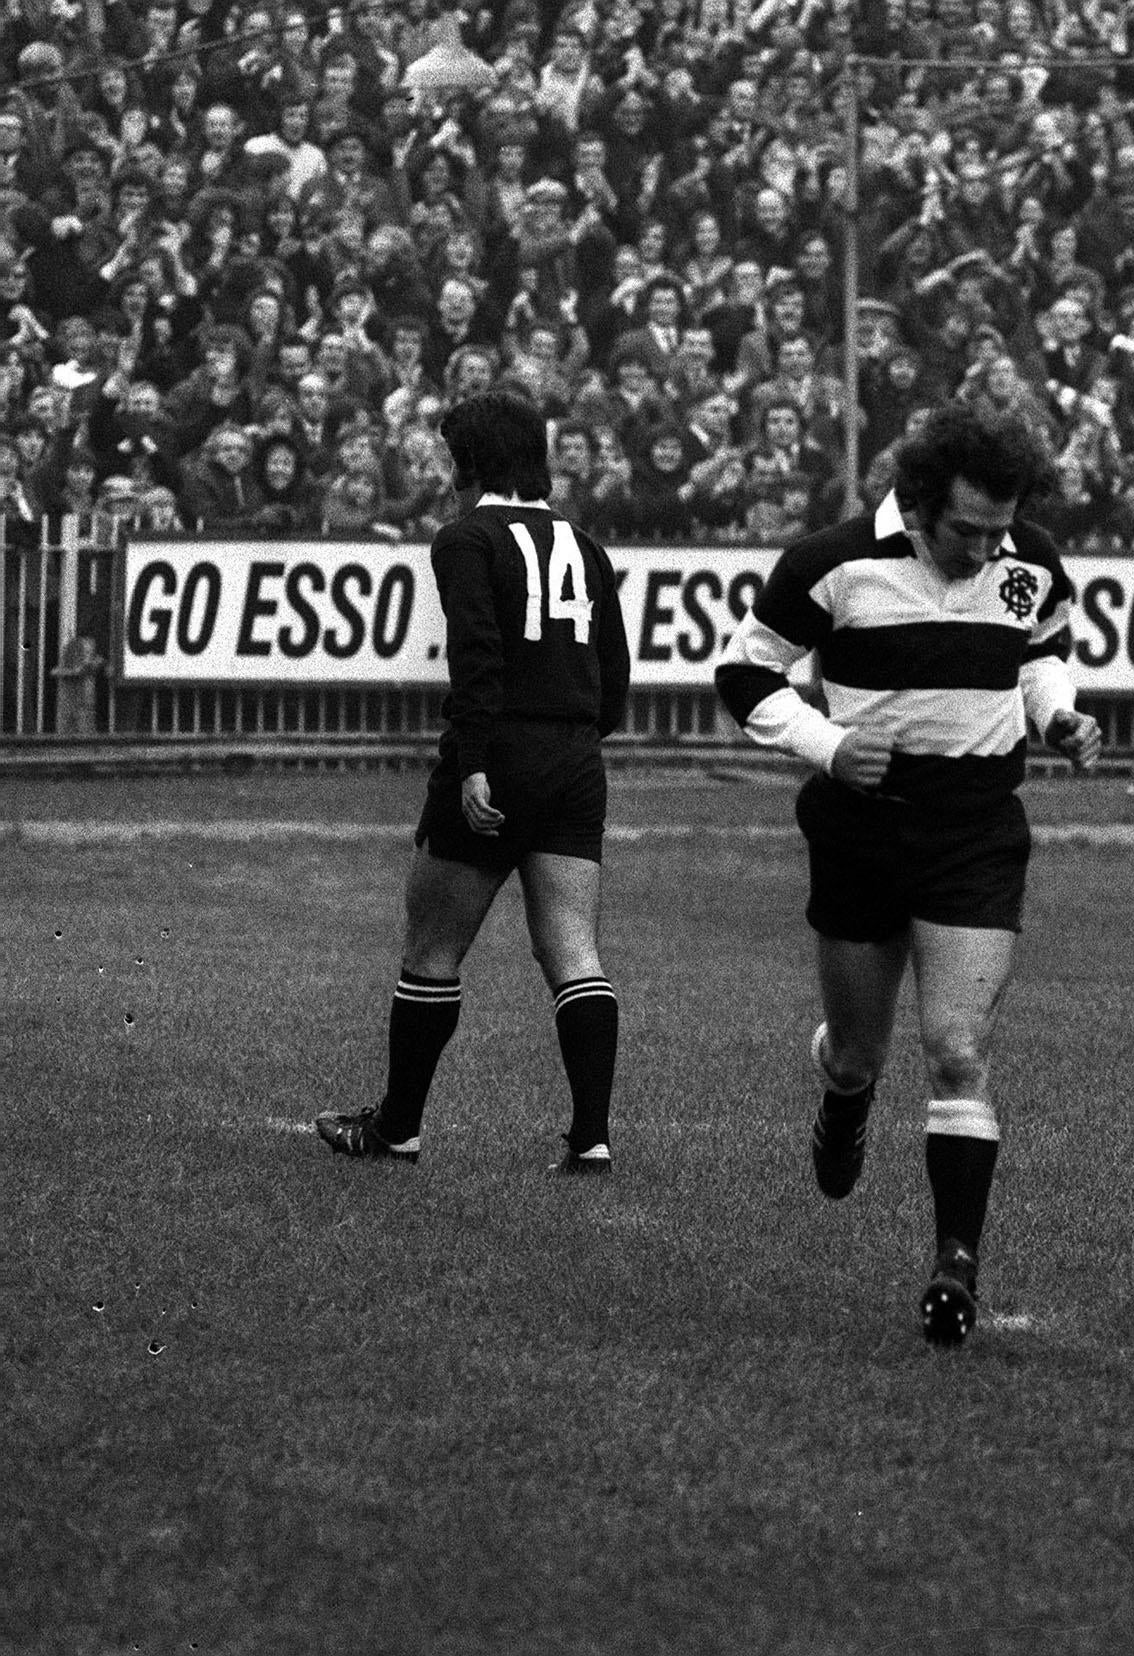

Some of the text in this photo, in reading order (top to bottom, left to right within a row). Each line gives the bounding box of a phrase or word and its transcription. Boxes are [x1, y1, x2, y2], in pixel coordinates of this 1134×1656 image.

[127, 560, 222, 657] GO
[235, 561, 416, 660] ESSO
[507, 520, 594, 644] 14
